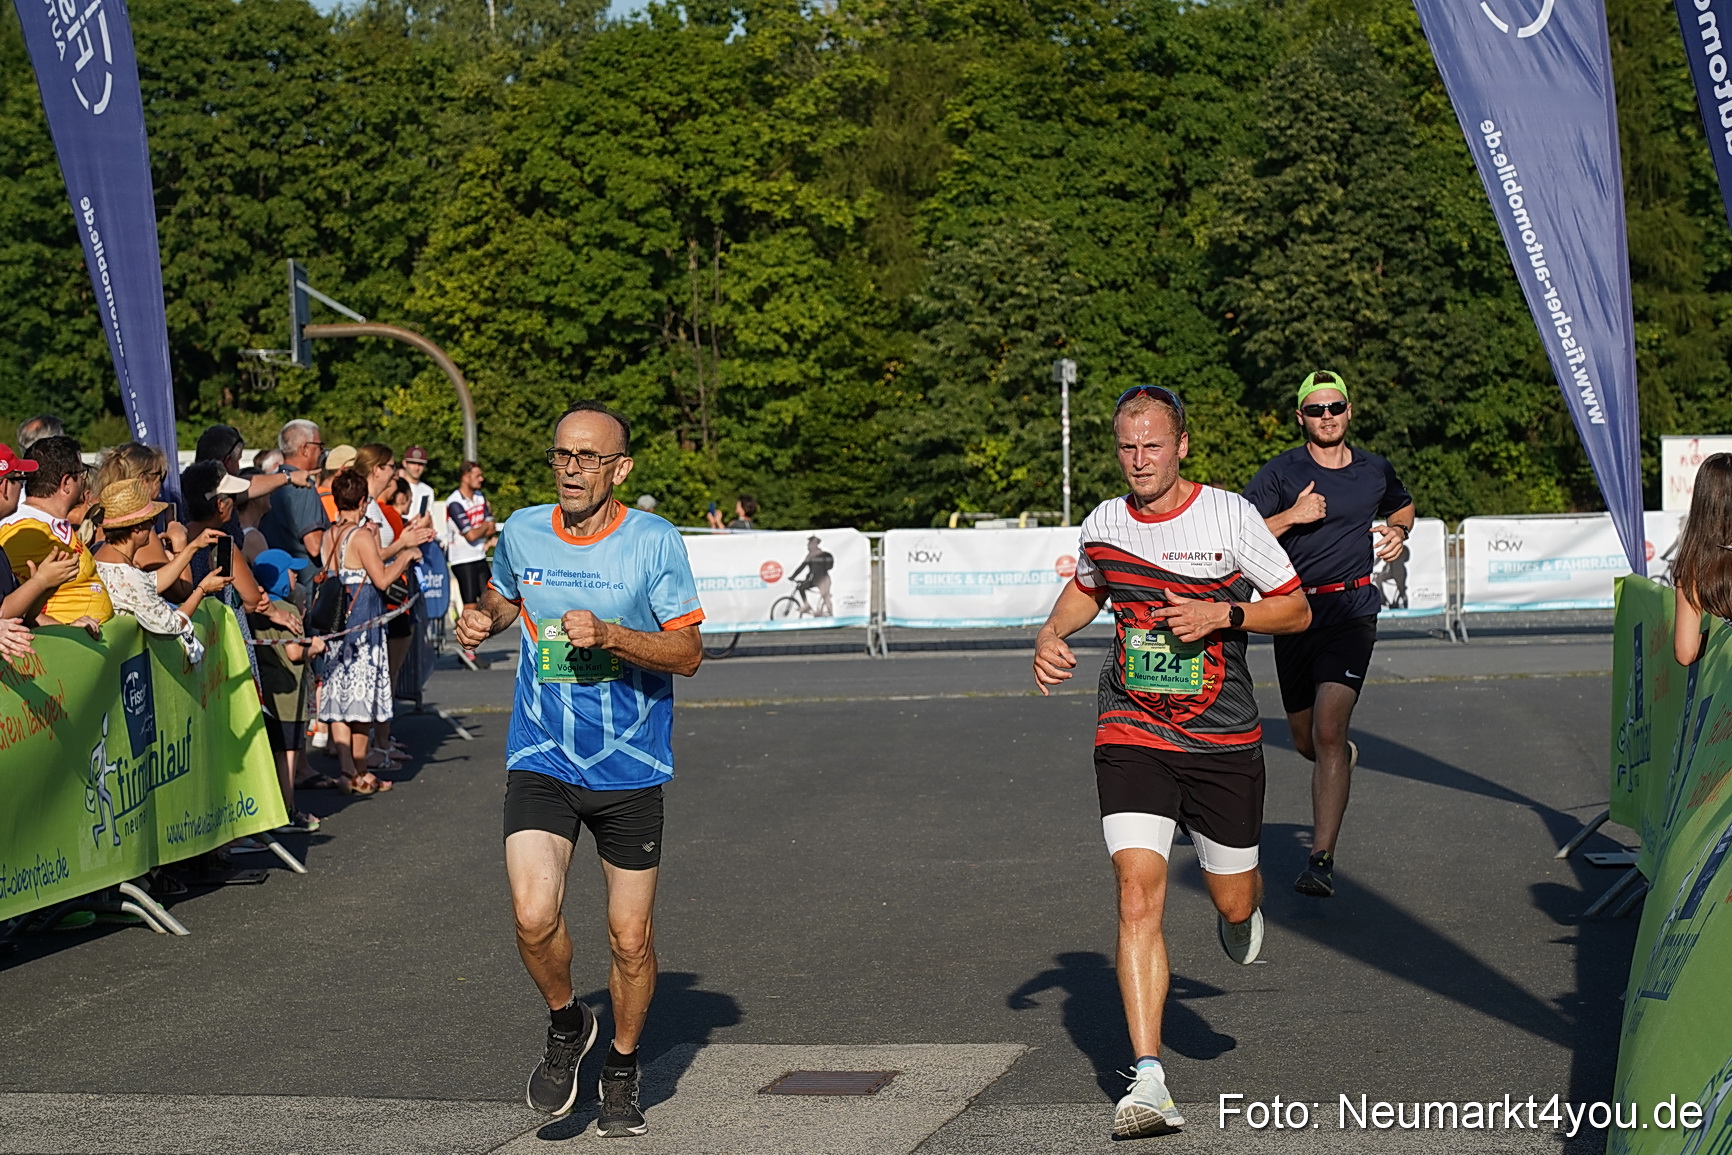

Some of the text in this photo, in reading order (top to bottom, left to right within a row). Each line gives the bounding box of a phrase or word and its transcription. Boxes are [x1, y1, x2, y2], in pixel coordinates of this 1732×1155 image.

[1488, 540, 1523, 551] NOW
[908, 551, 942, 563] NOW
[1162, 551, 1213, 561] NEUMARKT
[1543, 560, 1552, 571] &
[546, 569, 601, 580] Raiffeisenbank
[965, 574, 975, 584] &
[545, 579, 583, 588] Neumarkt
[613, 582, 624, 590] eG
[565, 641, 593, 663] 26
[542, 648, 550, 670] RUN
[1142, 651, 1183, 673] 124
[1134, 671, 1190, 683] Neuner Markus
[1190, 657, 1200, 686] 2022
